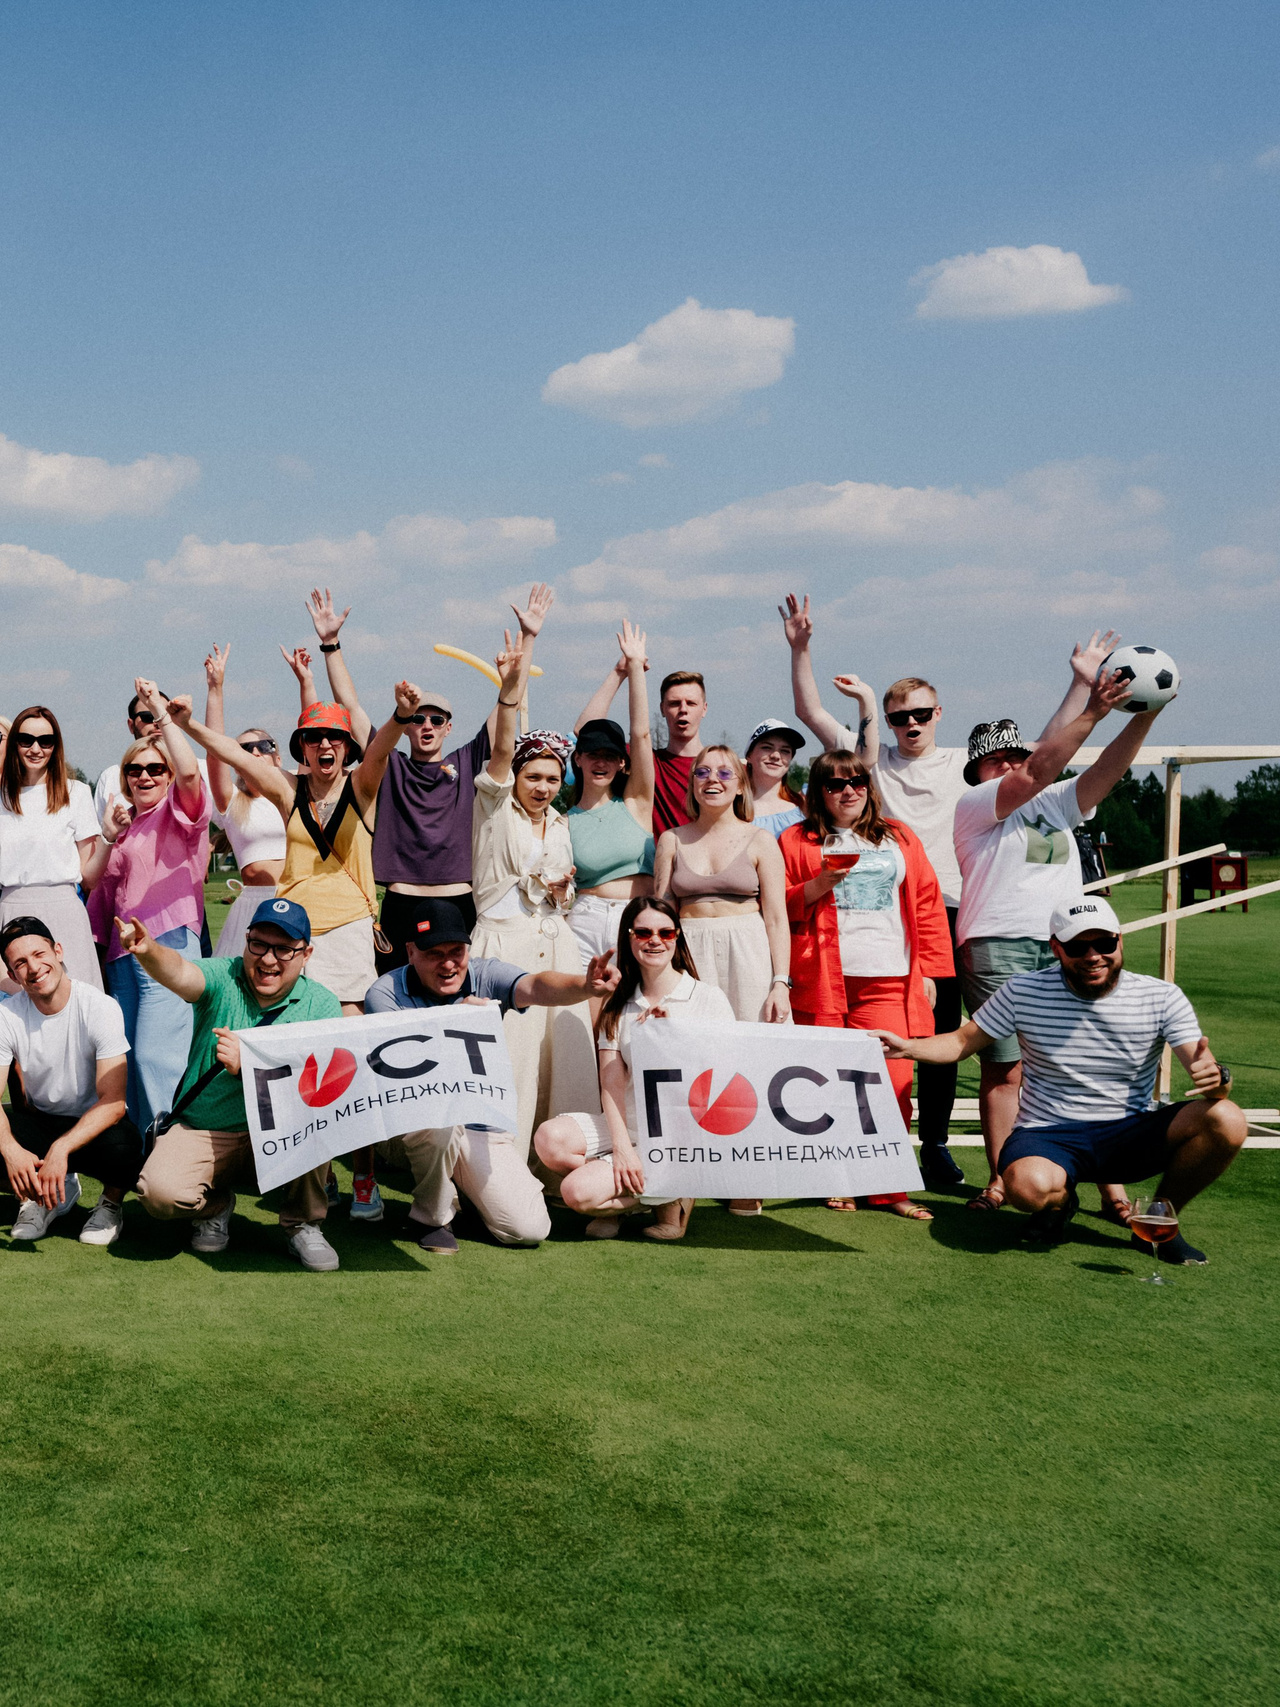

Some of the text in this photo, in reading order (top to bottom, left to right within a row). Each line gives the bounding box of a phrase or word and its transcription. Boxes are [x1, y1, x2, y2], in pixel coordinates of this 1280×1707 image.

[262, 1080, 507, 1156] ОТЕЛЬ МЕНЕДЖМЕНТ
[643, 1065, 882, 1138] ГОСТ
[648, 1142, 901, 1163] ОТЕЛЬ МЕНЕДЖМЕНТ
